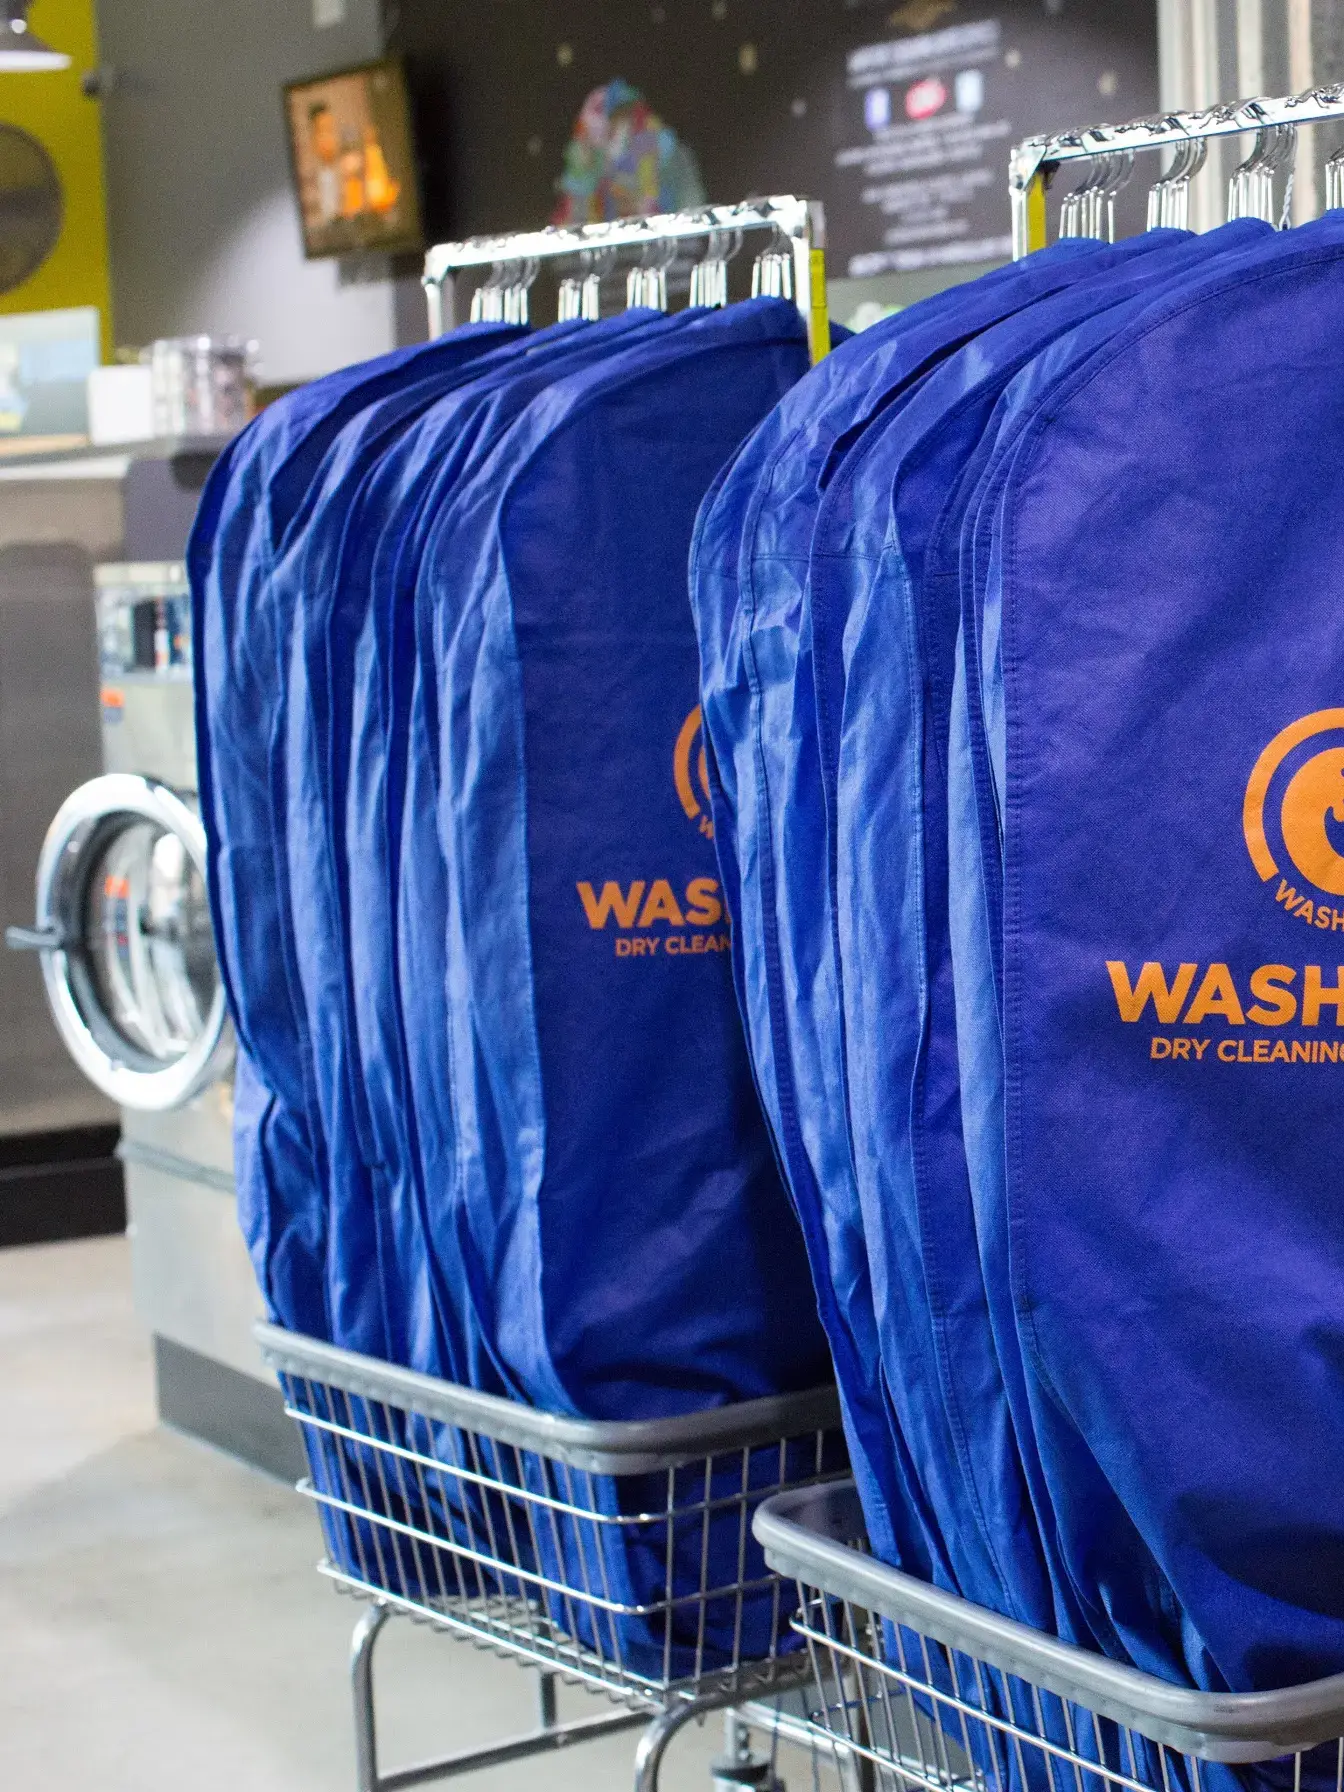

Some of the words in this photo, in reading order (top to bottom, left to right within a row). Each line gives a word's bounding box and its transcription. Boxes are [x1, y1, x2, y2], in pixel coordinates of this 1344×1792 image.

[575, 877, 733, 930] WAS
[614, 936, 660, 957] DRY
[1150, 1037, 1211, 1060] DRY
